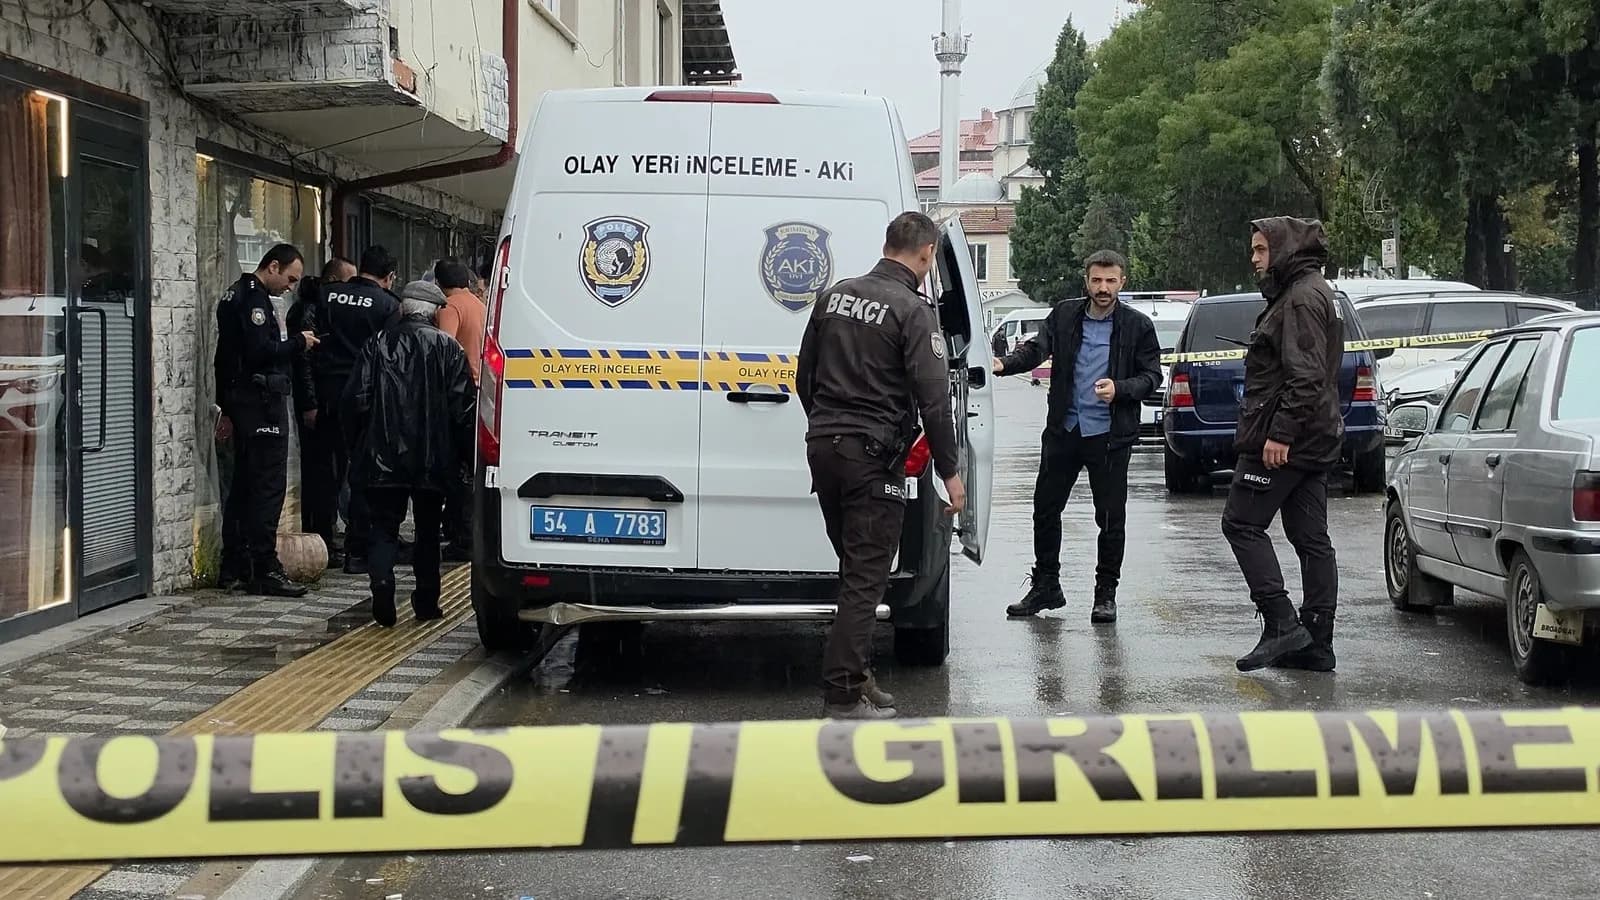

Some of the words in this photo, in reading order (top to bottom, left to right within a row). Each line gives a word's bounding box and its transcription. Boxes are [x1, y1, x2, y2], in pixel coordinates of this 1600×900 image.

[563, 155, 619, 174] OLAY
[542, 364, 572, 373] OLAY
[738, 367, 769, 378] OLAY
[773, 369, 797, 379] YER
[528, 430, 598, 439] TRANSIT
[544, 511, 567, 533] 54
[584, 512, 596, 534] A
[614, 513, 661, 536] 7783
